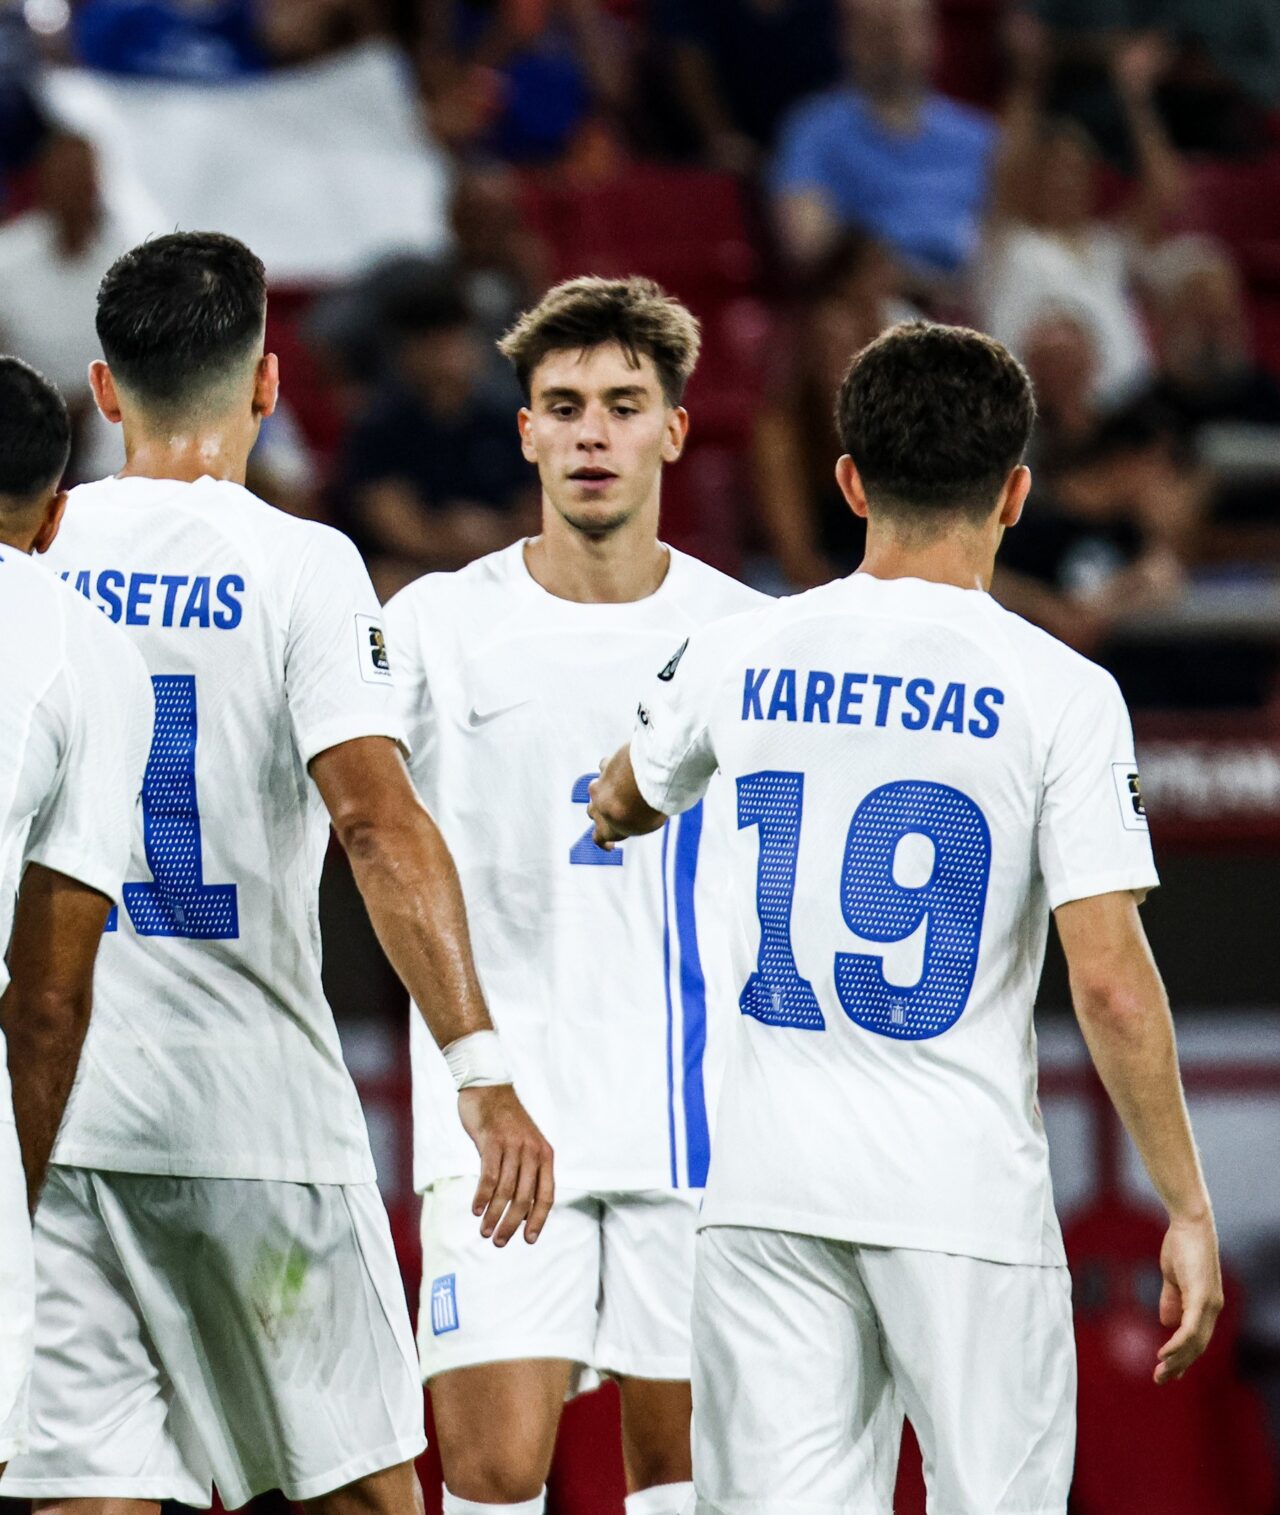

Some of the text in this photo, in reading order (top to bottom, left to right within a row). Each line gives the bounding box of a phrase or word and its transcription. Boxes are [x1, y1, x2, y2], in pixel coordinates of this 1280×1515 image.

[54, 569, 246, 631] SETAS
[741, 667, 1005, 740] KARETSAS
[104, 673, 240, 941] 1
[735, 769, 993, 1042] 19
